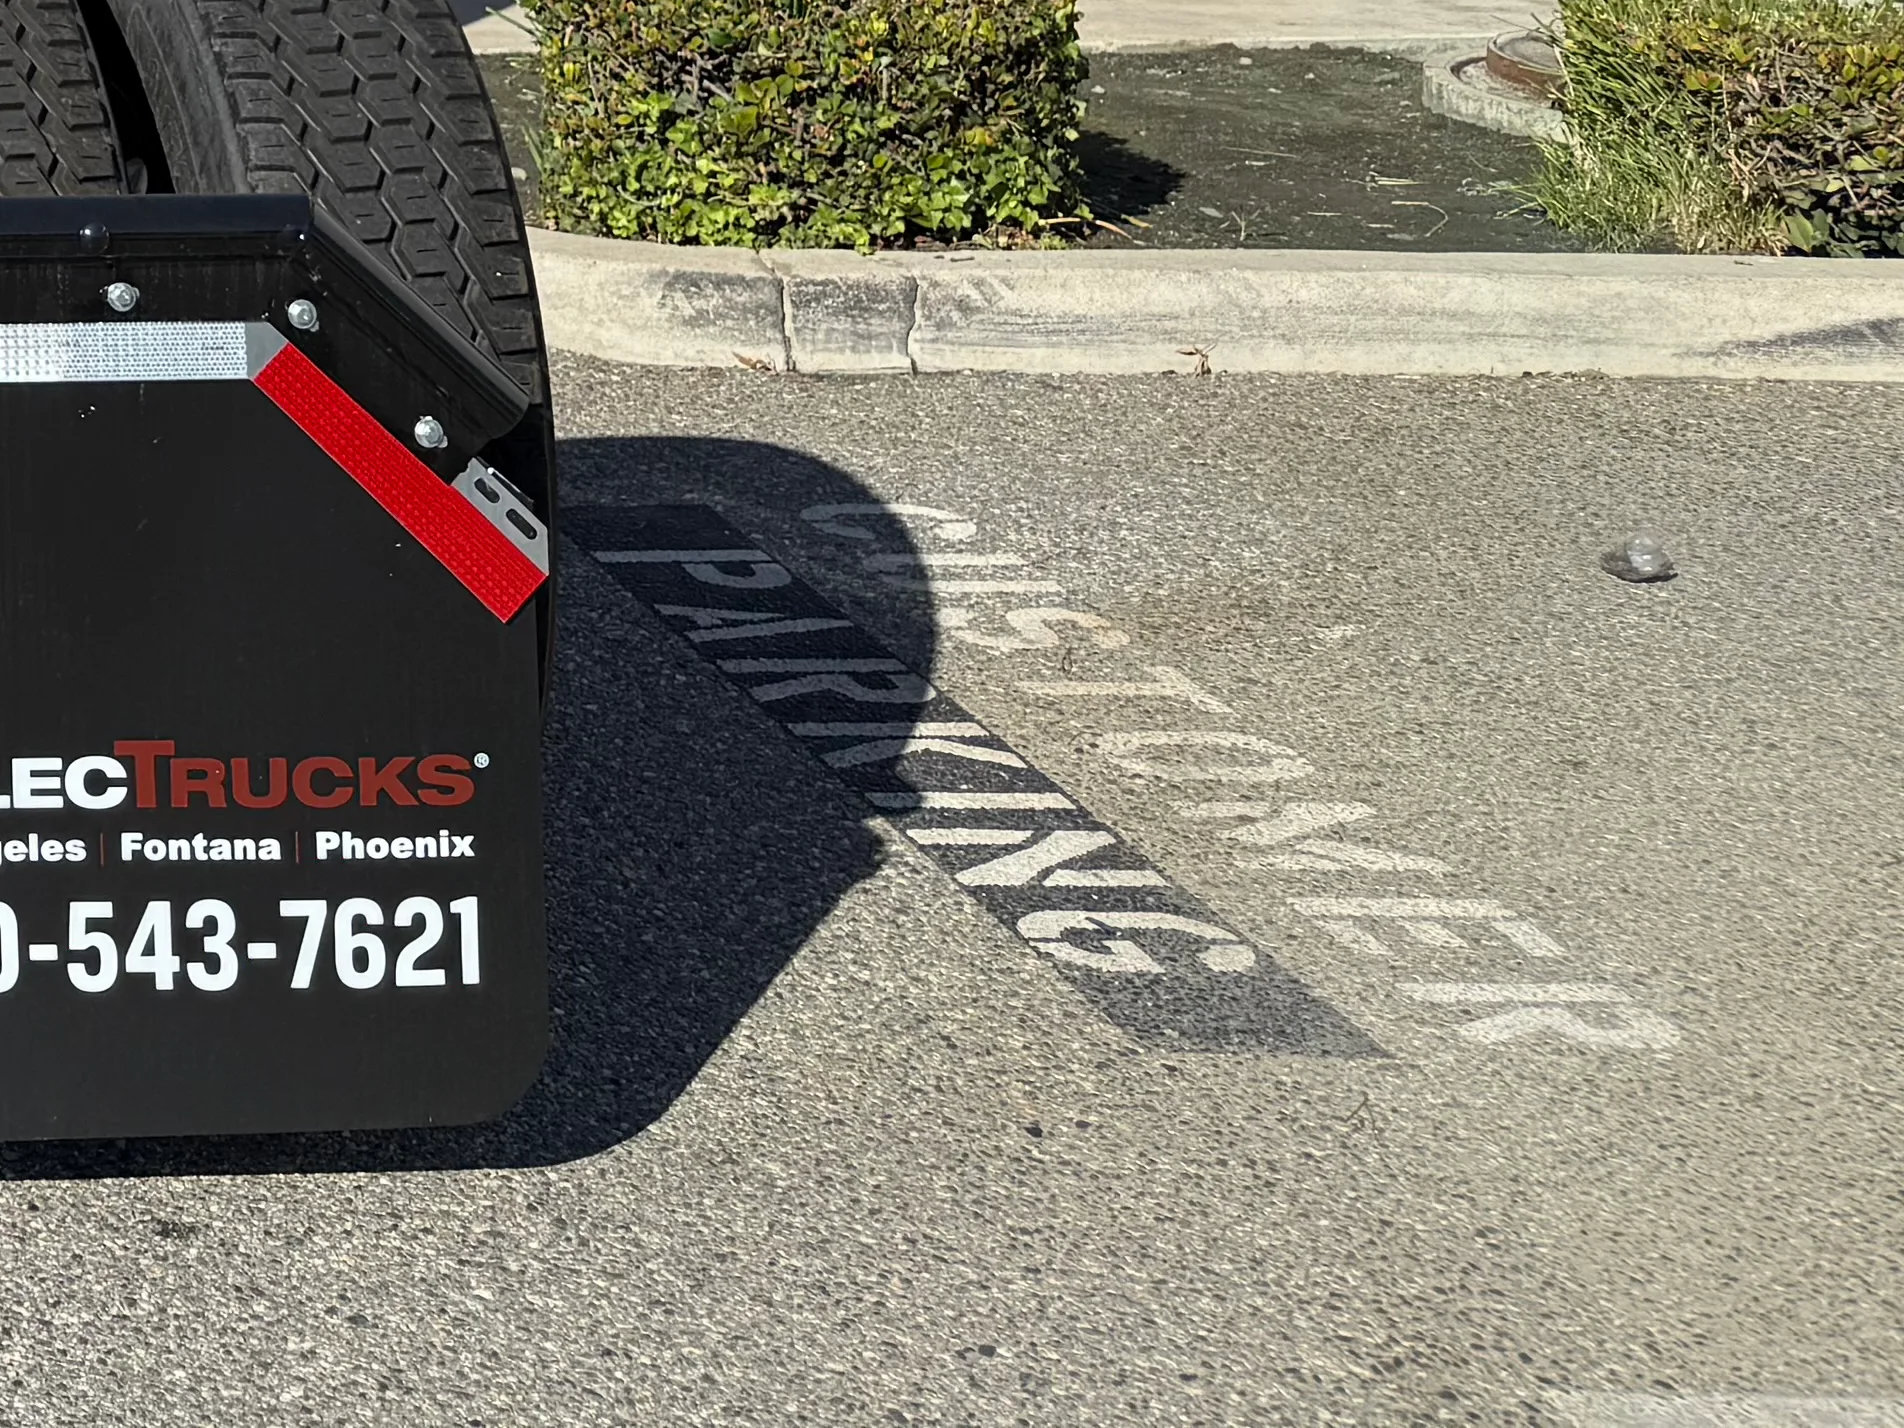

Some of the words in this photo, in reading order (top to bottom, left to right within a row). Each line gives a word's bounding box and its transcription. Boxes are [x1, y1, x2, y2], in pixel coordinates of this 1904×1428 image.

[120, 832, 282, 862] Fontana
[315, 829, 476, 861] Phoenix
[595, 547, 1256, 974] PARKING
[799, 500, 1682, 1050] CUSTOMER
